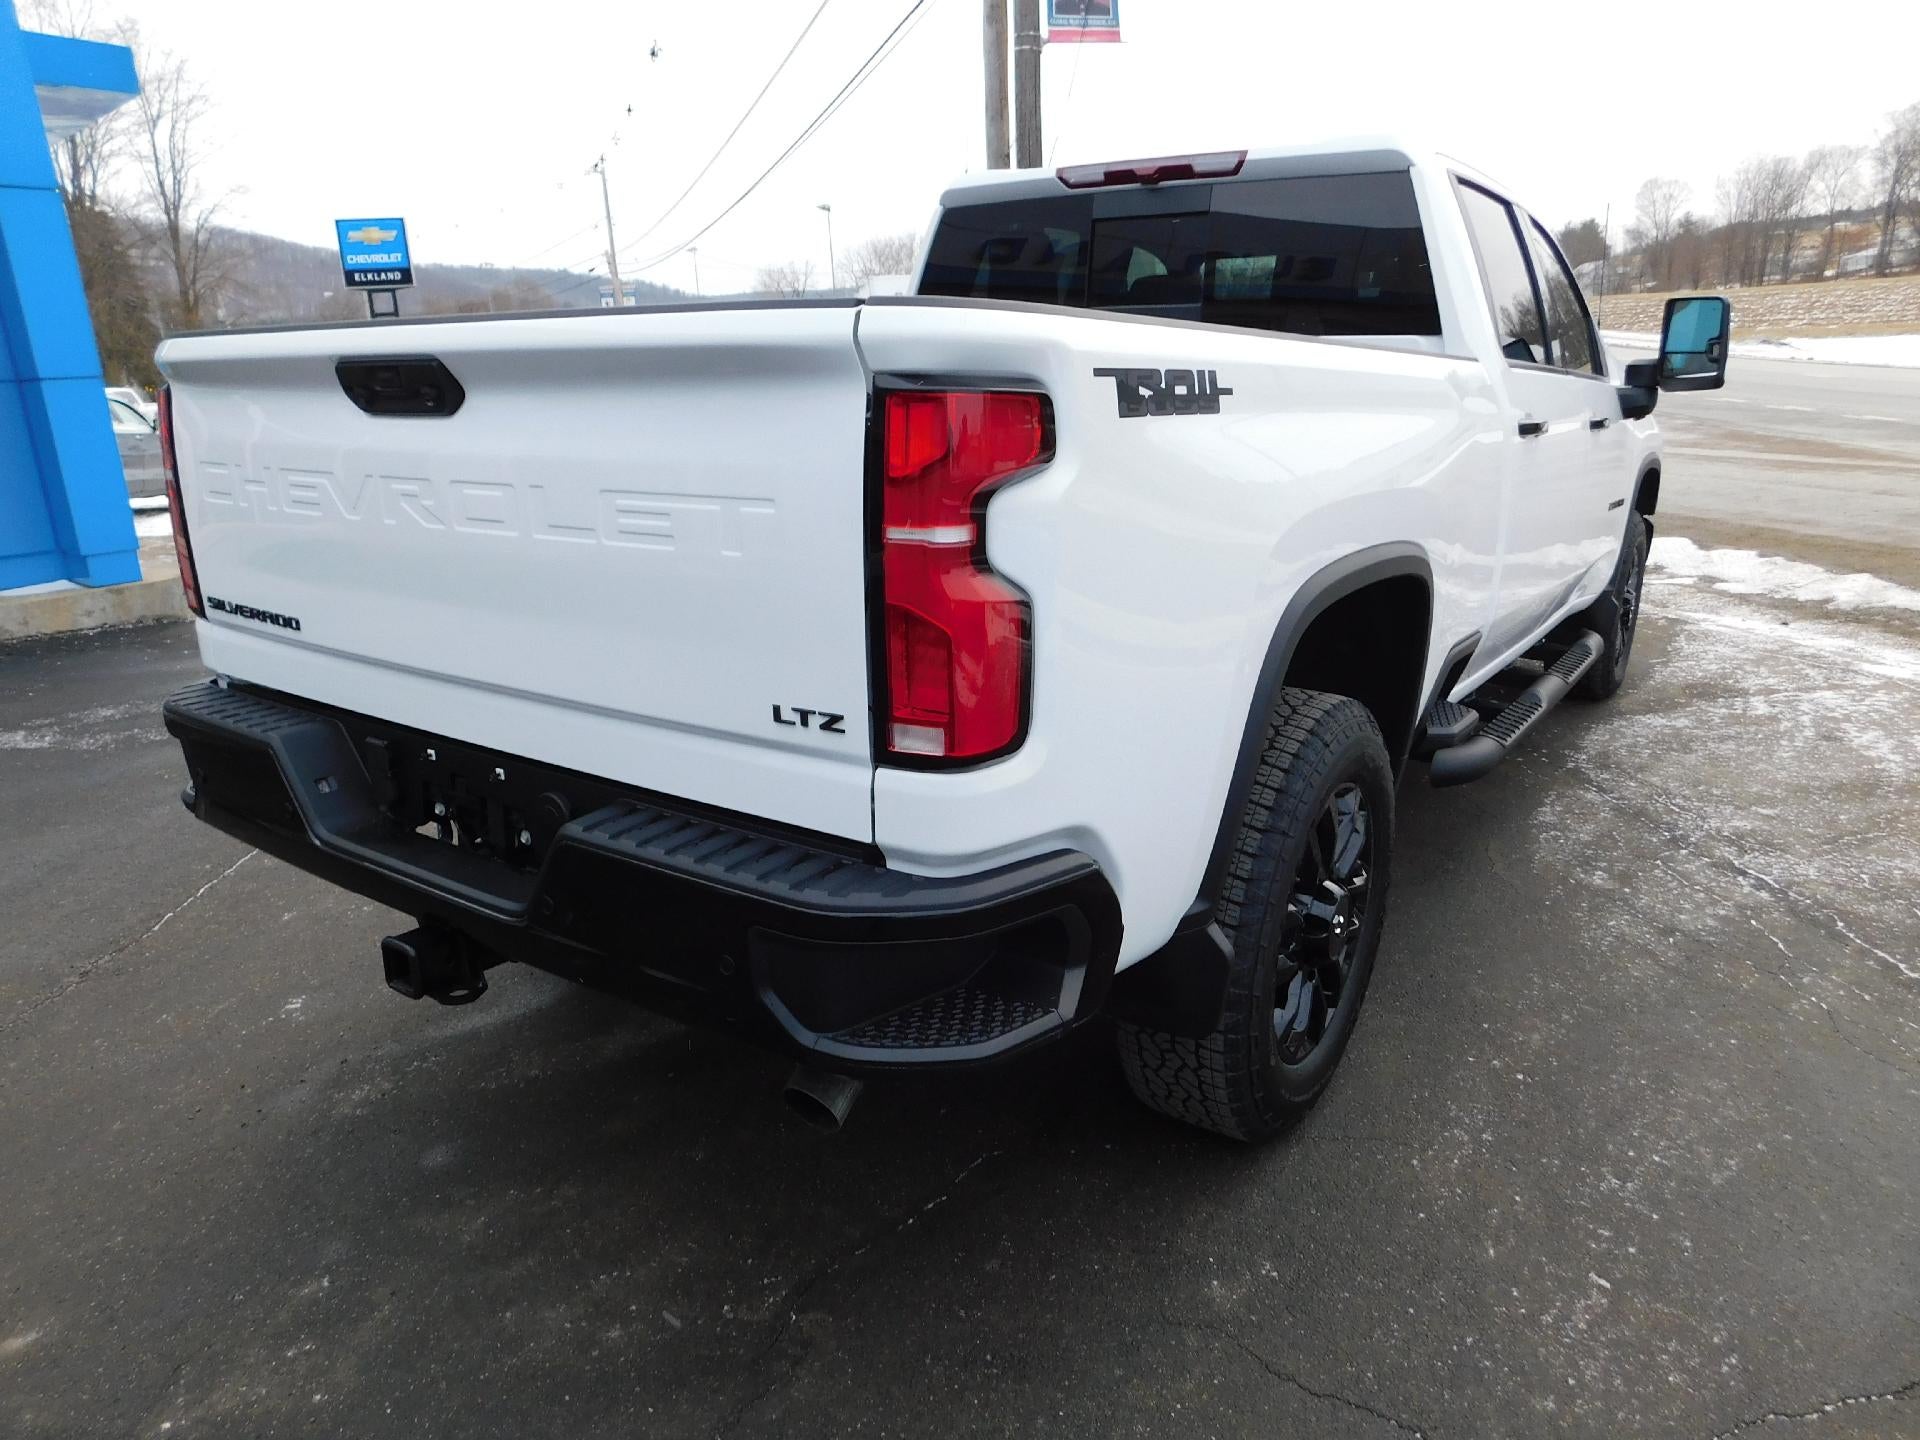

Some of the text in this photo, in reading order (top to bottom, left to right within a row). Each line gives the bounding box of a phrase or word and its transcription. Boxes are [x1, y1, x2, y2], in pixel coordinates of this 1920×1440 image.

[347, 253, 402, 264] CHEVROLET
[354, 271, 402, 281] ELKLAND
[199, 461, 776, 556] CHEVROLET
[207, 596, 301, 631] SILVERADO
[772, 704, 846, 734] LTZ
